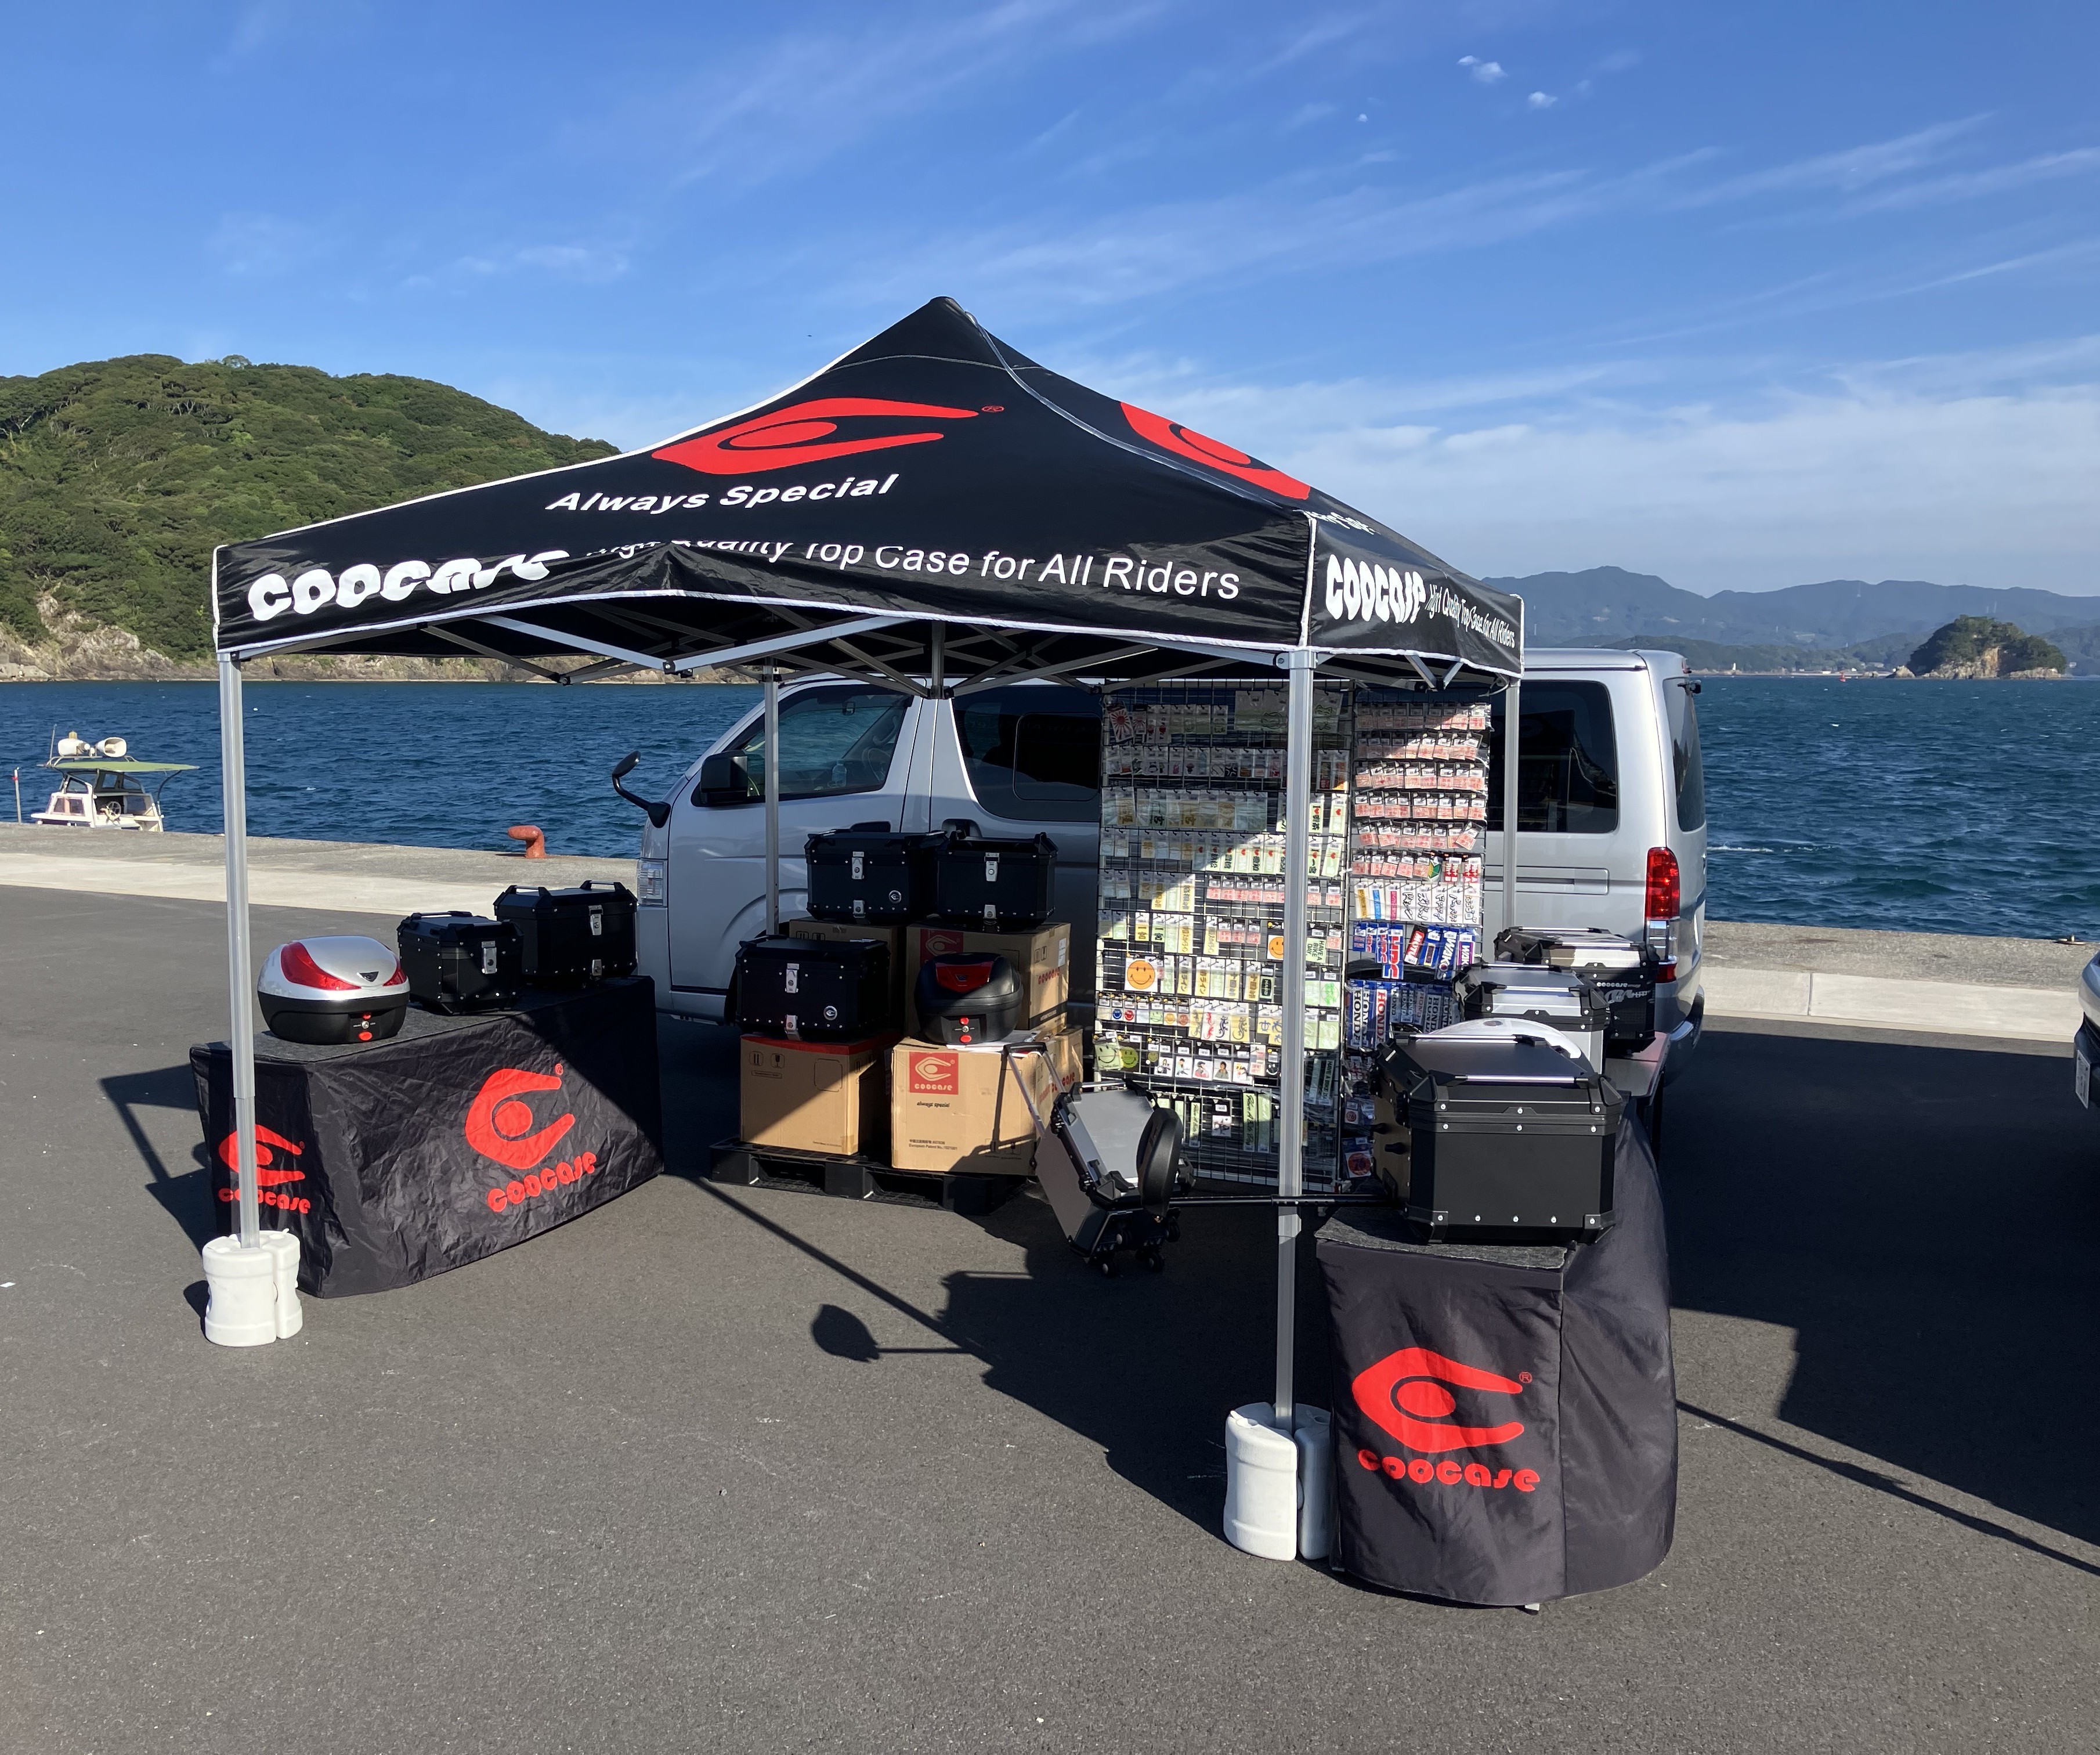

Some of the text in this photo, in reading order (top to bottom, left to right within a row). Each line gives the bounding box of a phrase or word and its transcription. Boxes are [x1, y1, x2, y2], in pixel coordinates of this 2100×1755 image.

[545, 473, 900, 515] Always Special
[875, 546, 970, 576] Case
[982, 551, 1036, 580] for
[1038, 554, 1093, 586] All
[1103, 557, 1241, 600] Riders
[1497, 620, 1515, 648] Riders
